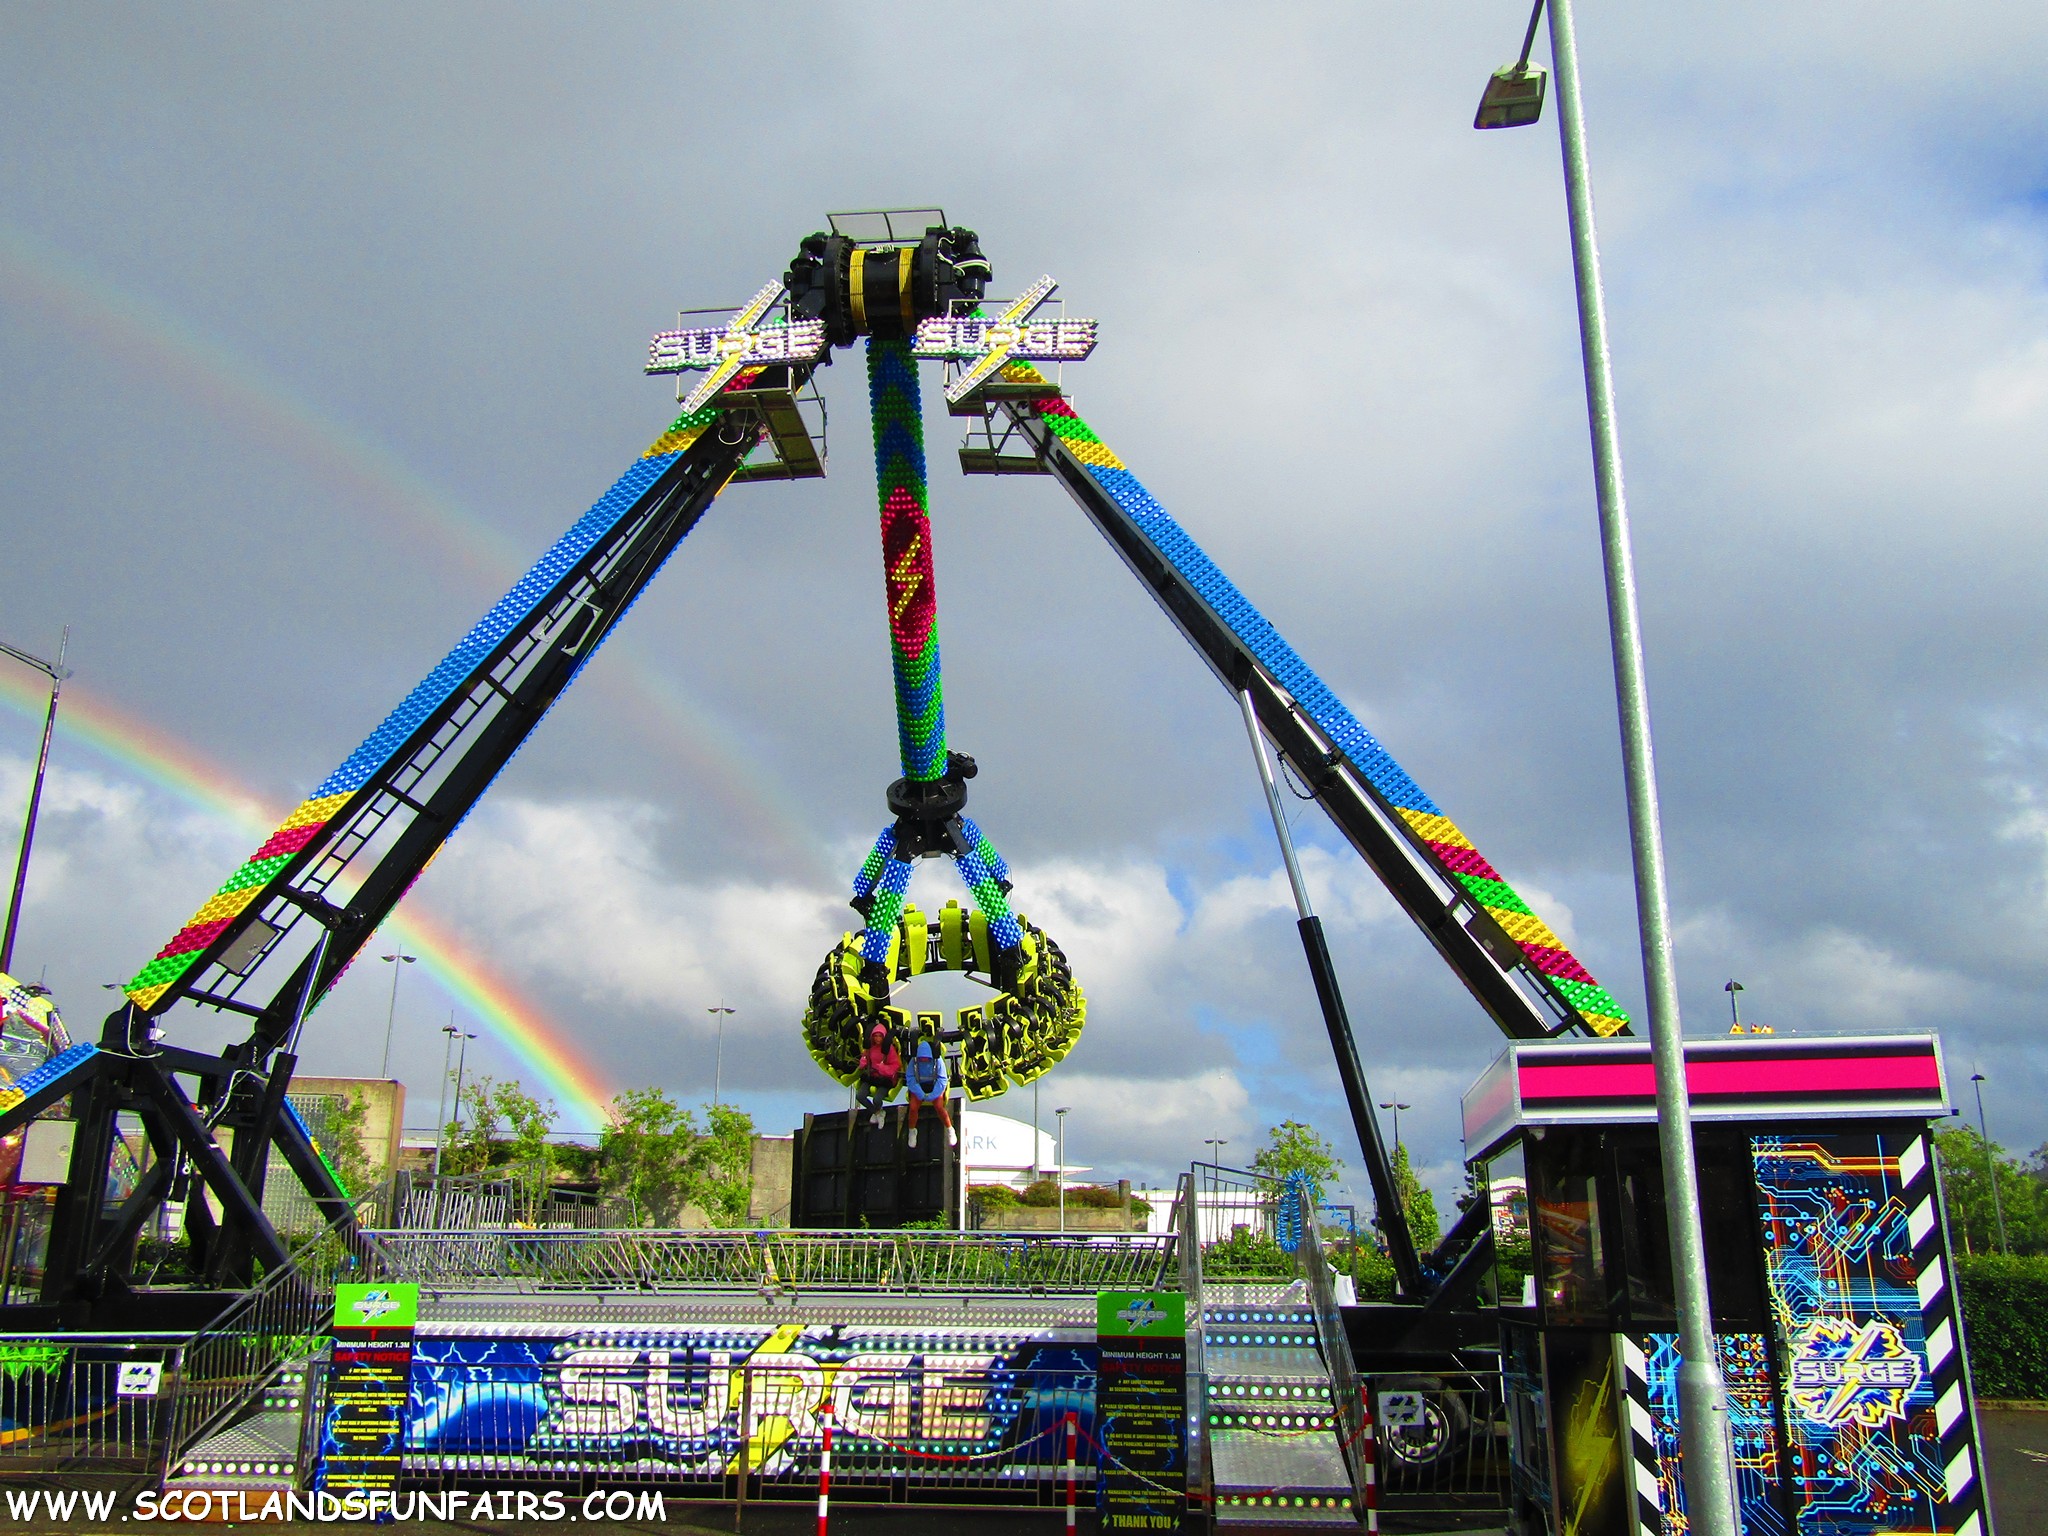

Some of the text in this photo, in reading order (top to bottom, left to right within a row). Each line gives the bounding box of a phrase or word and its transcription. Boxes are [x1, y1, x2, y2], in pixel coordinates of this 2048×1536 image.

[655, 324, 825, 365] SURGE
[922, 322, 1093, 354] SURGE
[335, 1352, 410, 1362] SAFETY NOTICE
[1102, 1351, 1135, 1359] MINIMUM
[1165, 1352, 1182, 1360] 1.3M
[1102, 1363, 1182, 1374] SAFETY NOTICE
[1795, 1360, 1911, 1383] SURGE
[556, 1351, 998, 1440] SURGE
[1111, 1514, 1171, 1529] THANK YOU
